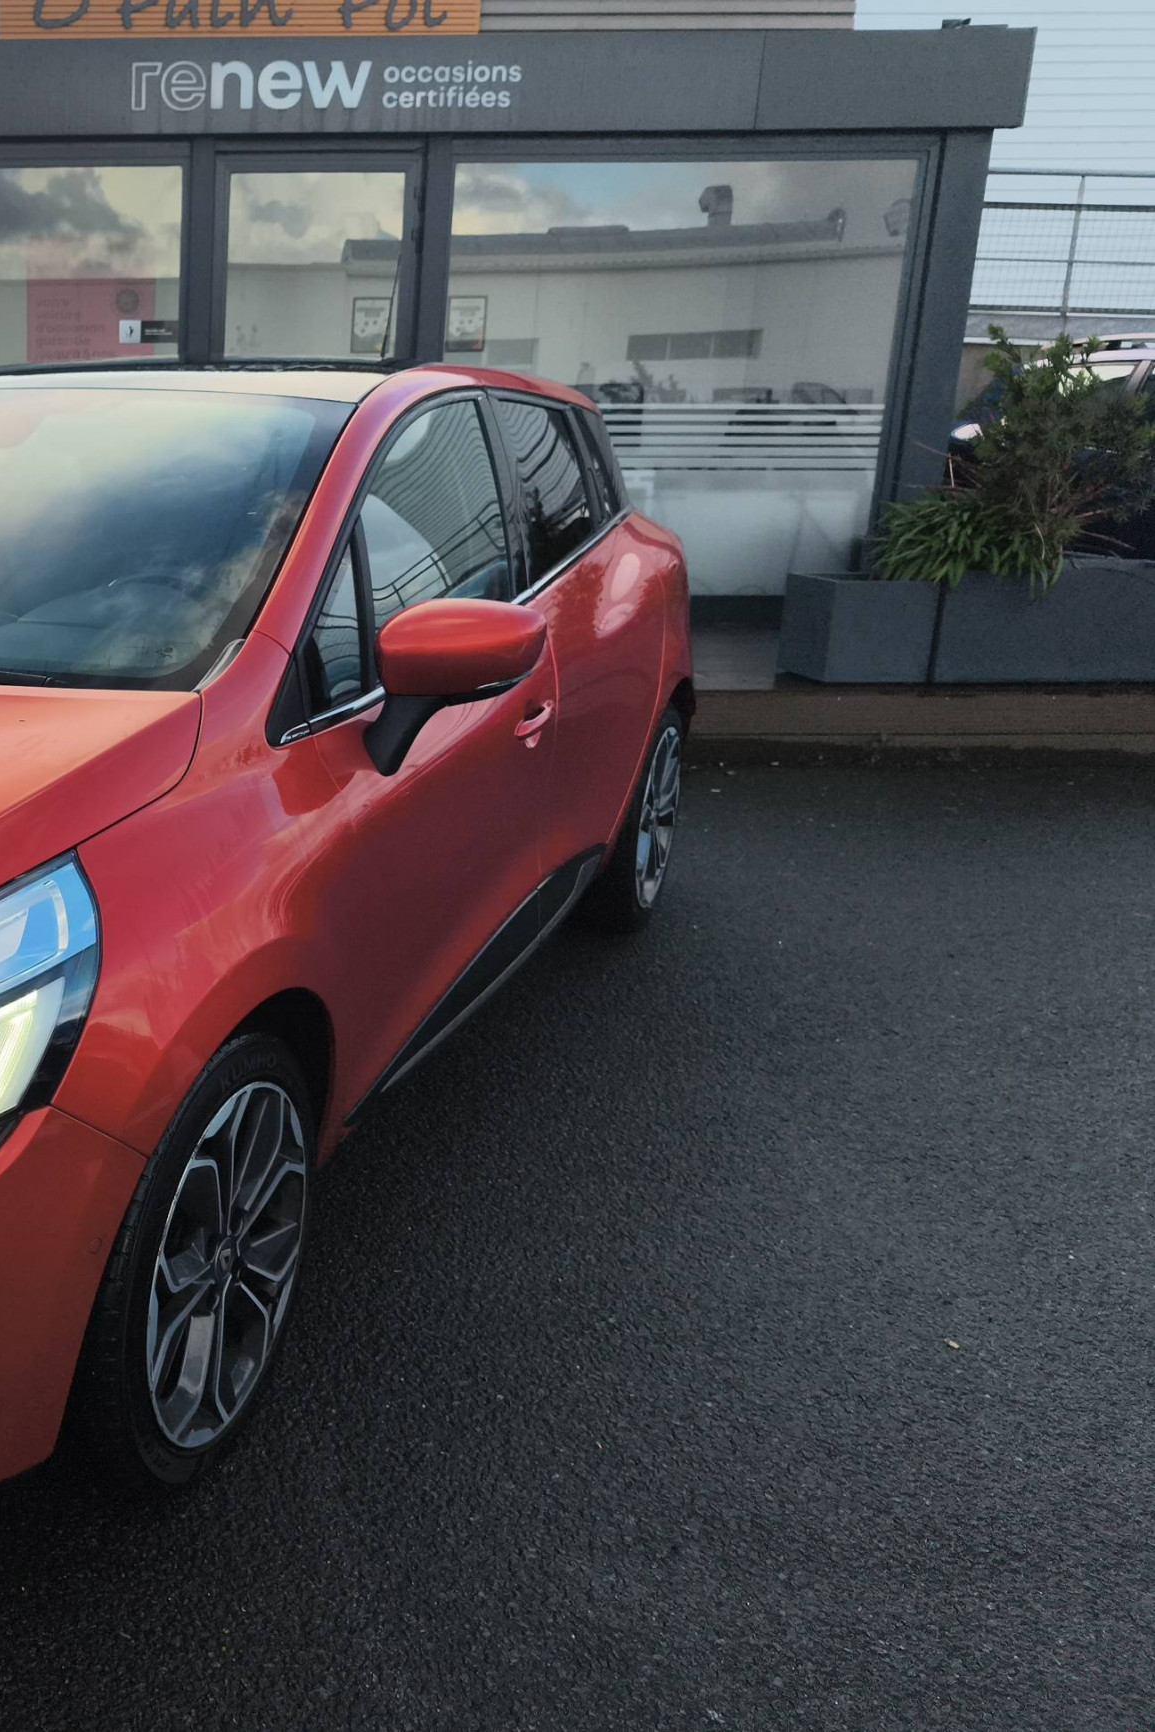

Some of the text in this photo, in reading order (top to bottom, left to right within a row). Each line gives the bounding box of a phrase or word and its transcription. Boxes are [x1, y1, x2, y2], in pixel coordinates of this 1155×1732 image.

[131, 60, 522, 111] renew occasions
[382, 85, 511, 109] certifiées
[220, 1052, 278, 1094] KUMHO
